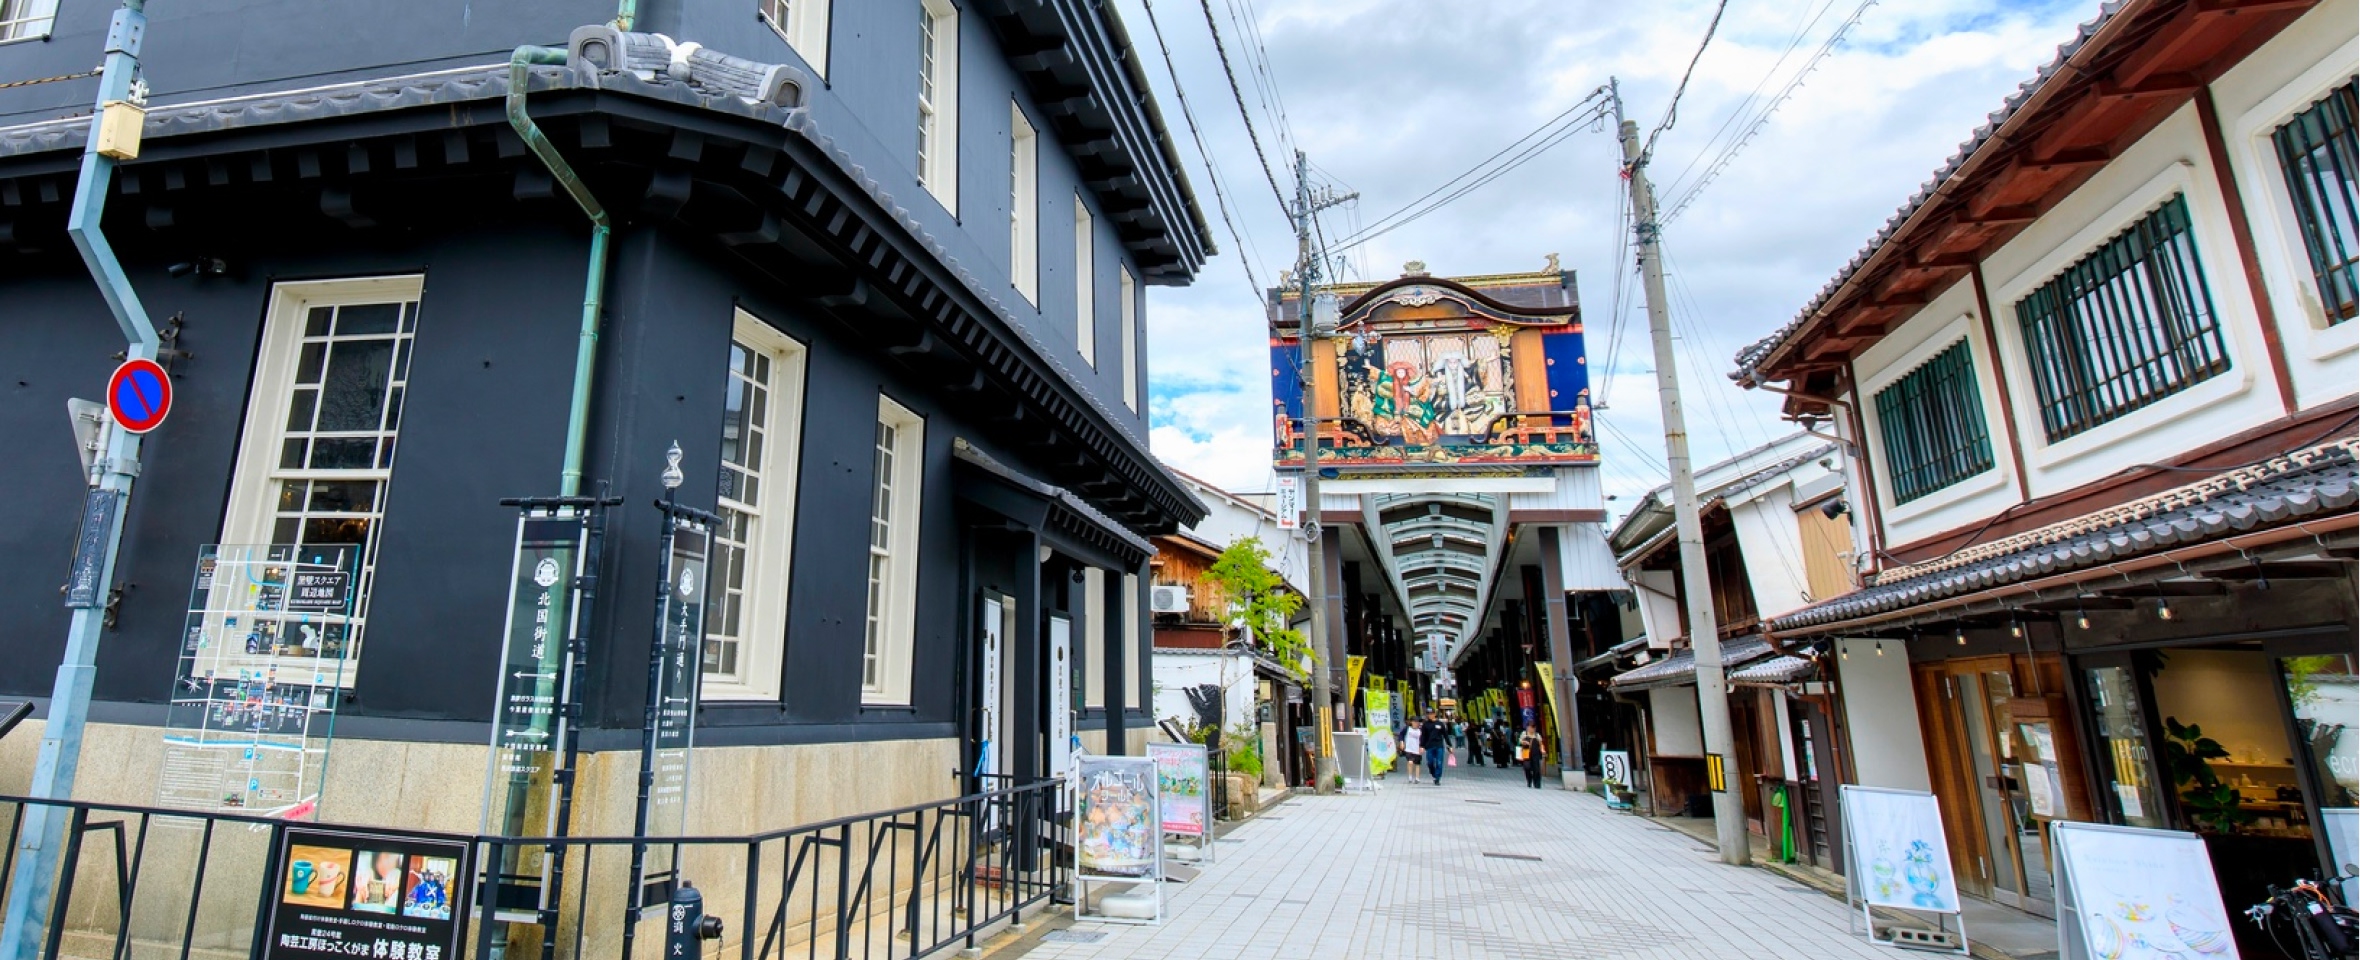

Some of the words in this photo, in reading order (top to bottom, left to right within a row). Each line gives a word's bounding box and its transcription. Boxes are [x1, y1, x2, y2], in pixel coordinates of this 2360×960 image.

[297, 575, 342, 586] 黒壁スクエア
[531, 591, 551, 659] 北国街道
[676, 601, 689, 684] 大手門通り
[1091, 769, 1145, 792] オルゴール
[280, 933, 370, 957] 陶芸工房ほっこくがま
[372, 938, 442, 960] 体験教室
